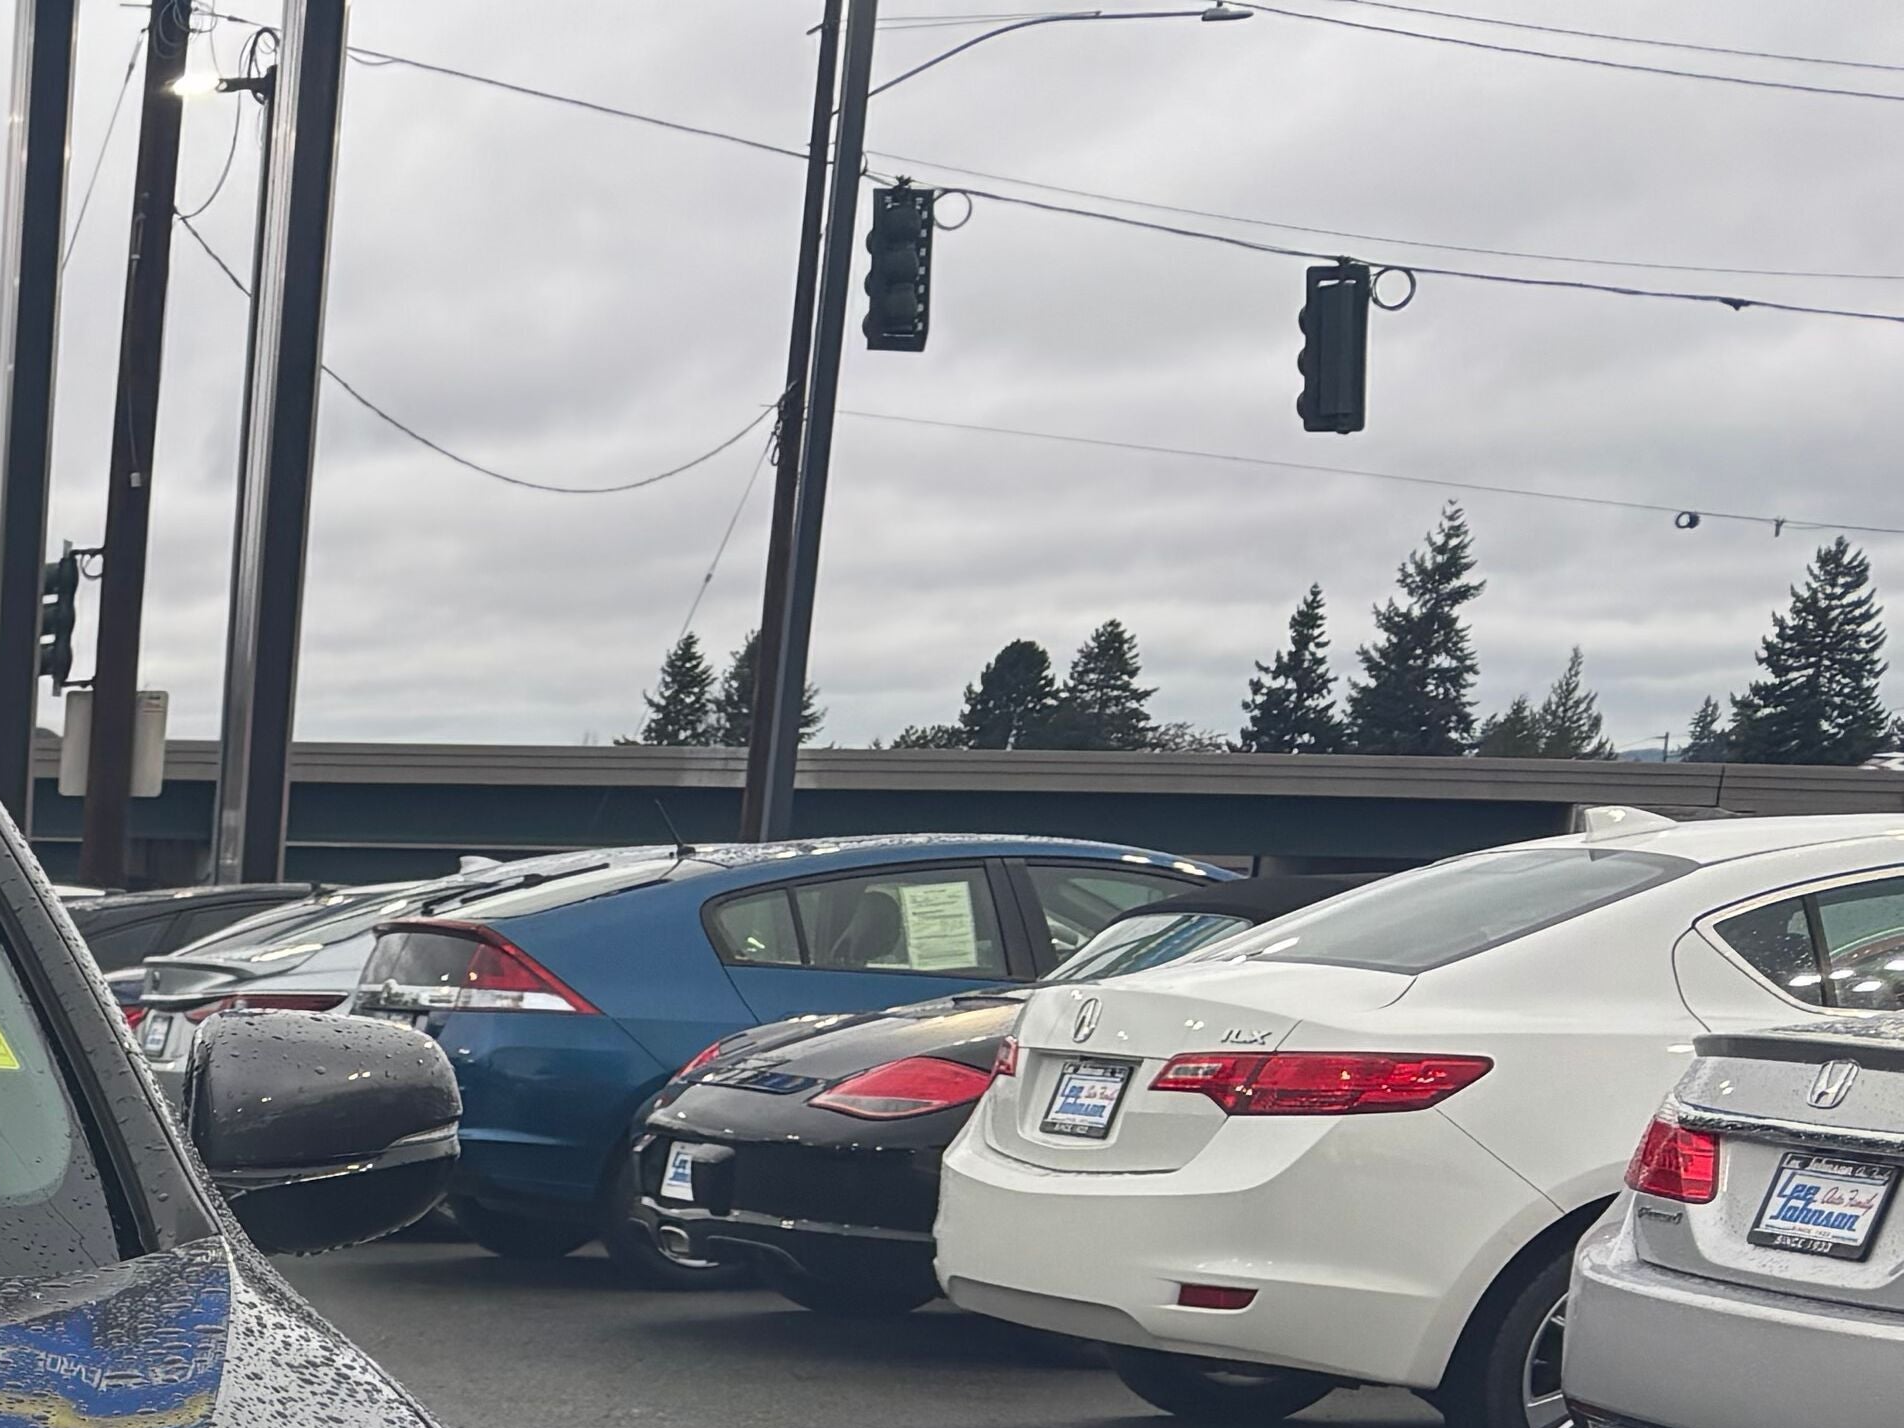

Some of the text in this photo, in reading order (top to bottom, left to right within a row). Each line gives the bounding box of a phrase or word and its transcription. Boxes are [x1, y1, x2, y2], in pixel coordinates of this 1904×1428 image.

[1220, 1029, 1273, 1046] ILX
[1777, 1172, 1821, 1202] Lee
[1769, 1199, 1861, 1231] Johnson
